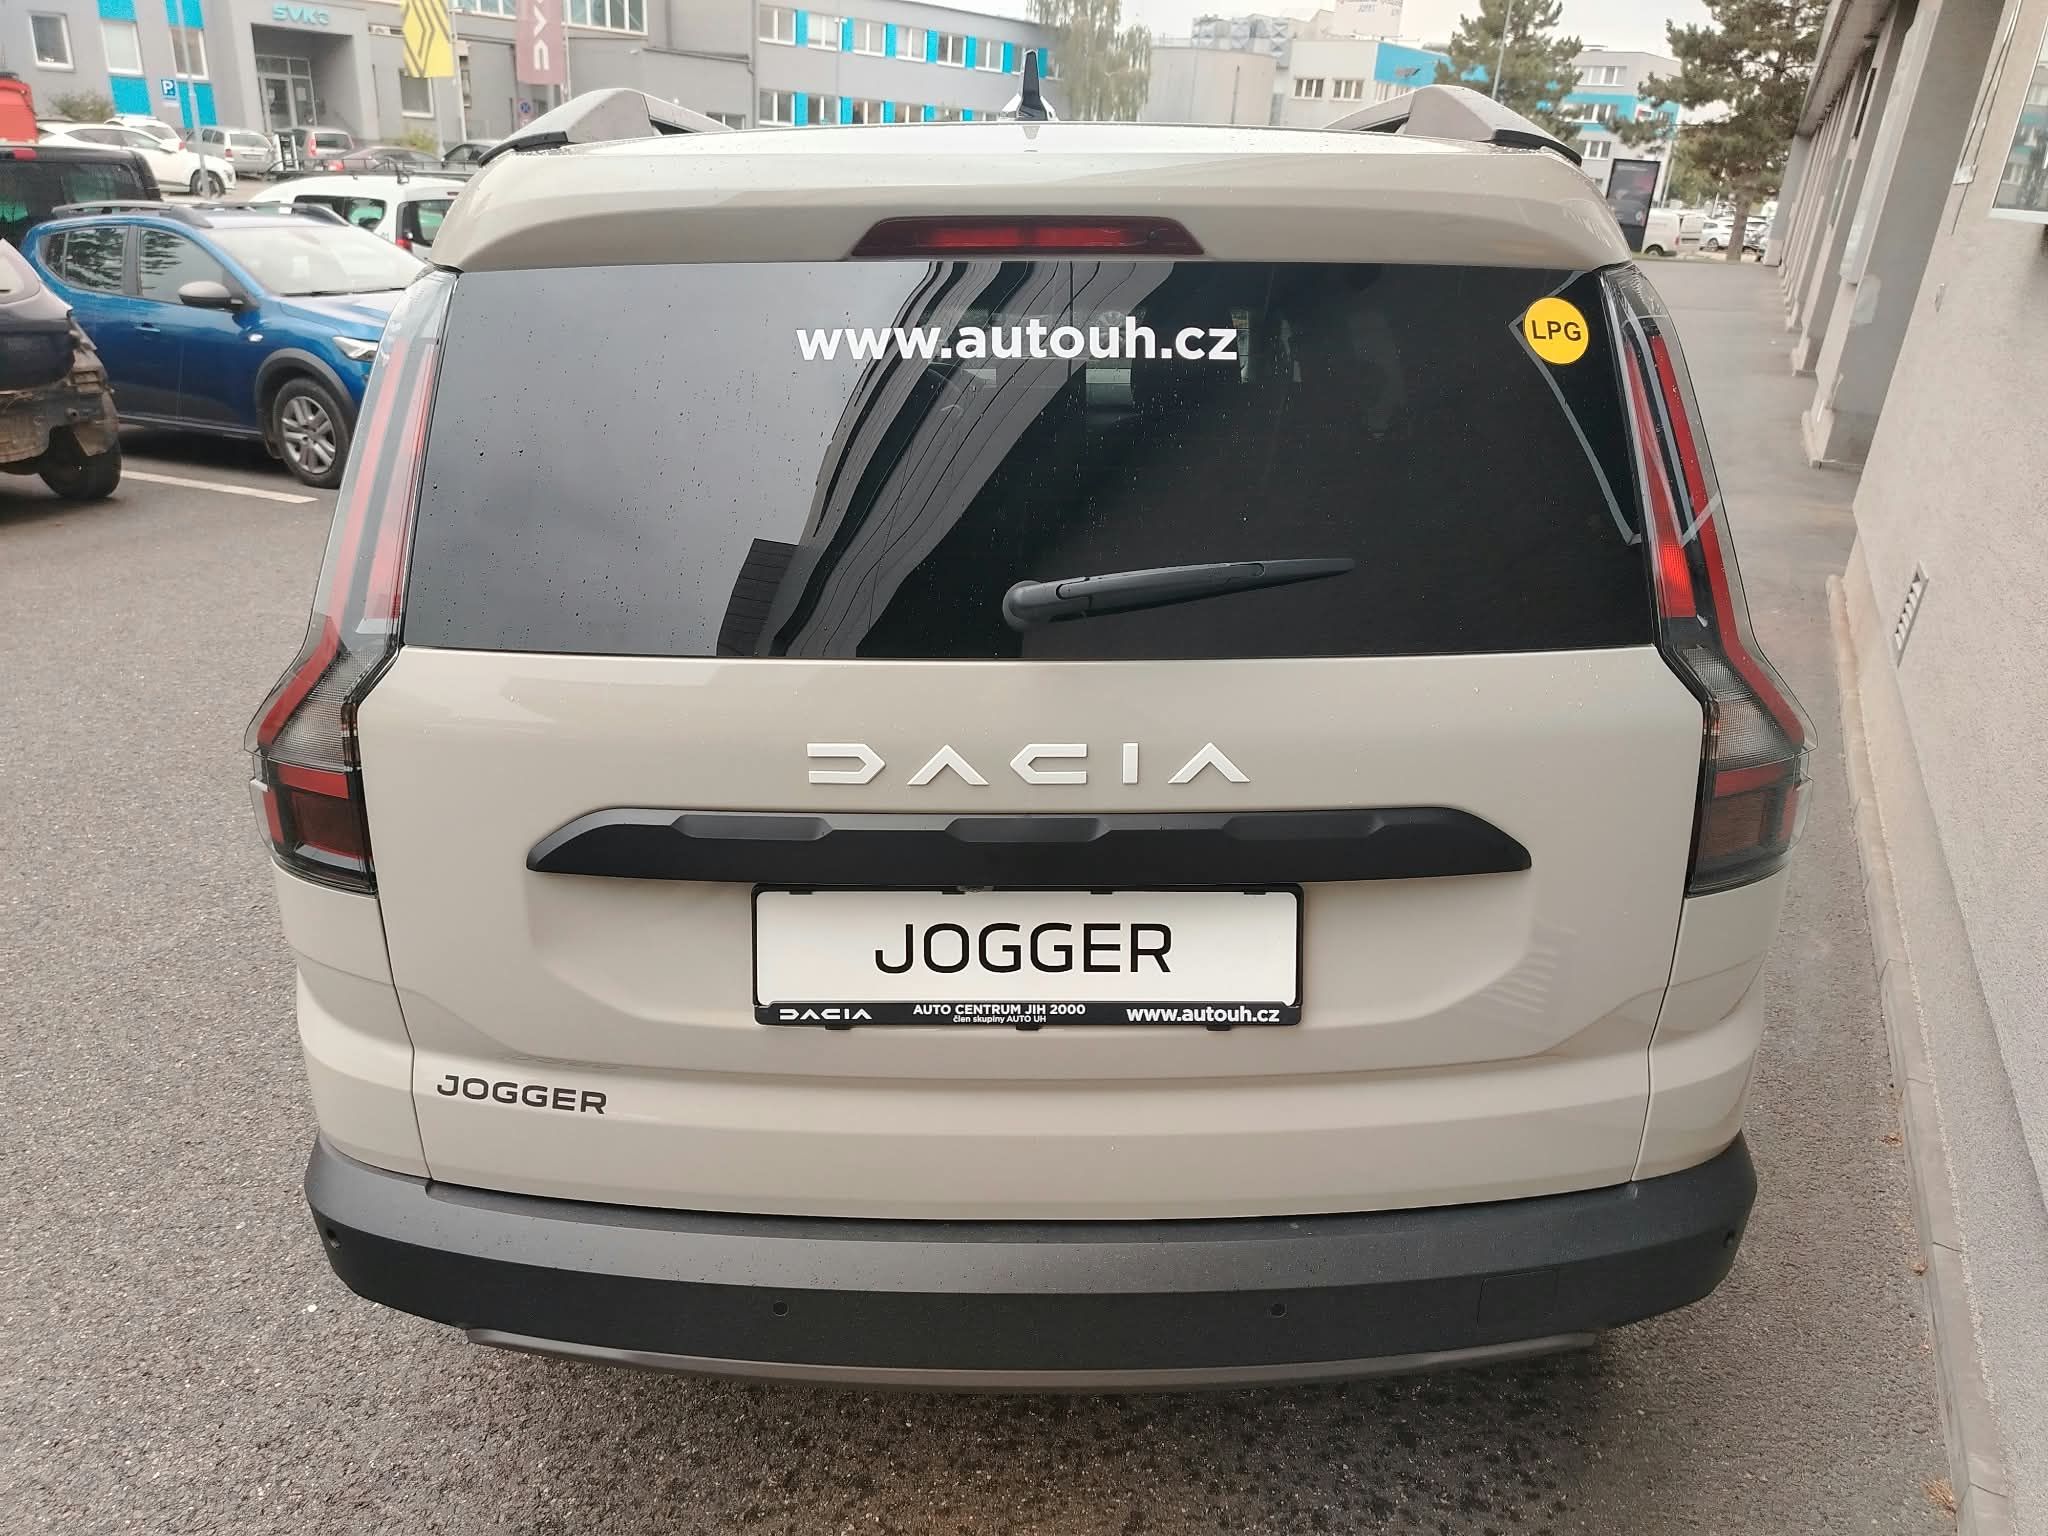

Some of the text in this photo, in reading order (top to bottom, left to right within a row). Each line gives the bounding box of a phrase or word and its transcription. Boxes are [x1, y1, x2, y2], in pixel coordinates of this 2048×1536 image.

[162, 80, 174, 95] P
[795, 316, 1238, 361] www.autouh.cz
[1531, 319, 1582, 342] LPG
[806, 742, 1251, 786] DACIA
[874, 922, 1172, 974] JOGGER
[779, 1008, 873, 1020] DACIA
[912, 1003, 1086, 1015] AUTO CENTRUM JIH 2000
[952, 1014, 1047, 1024] člen skupiny AUTO UH
[1126, 1005, 1280, 1022] www.autouh.cz
[436, 1074, 608, 1115] JOGGER
